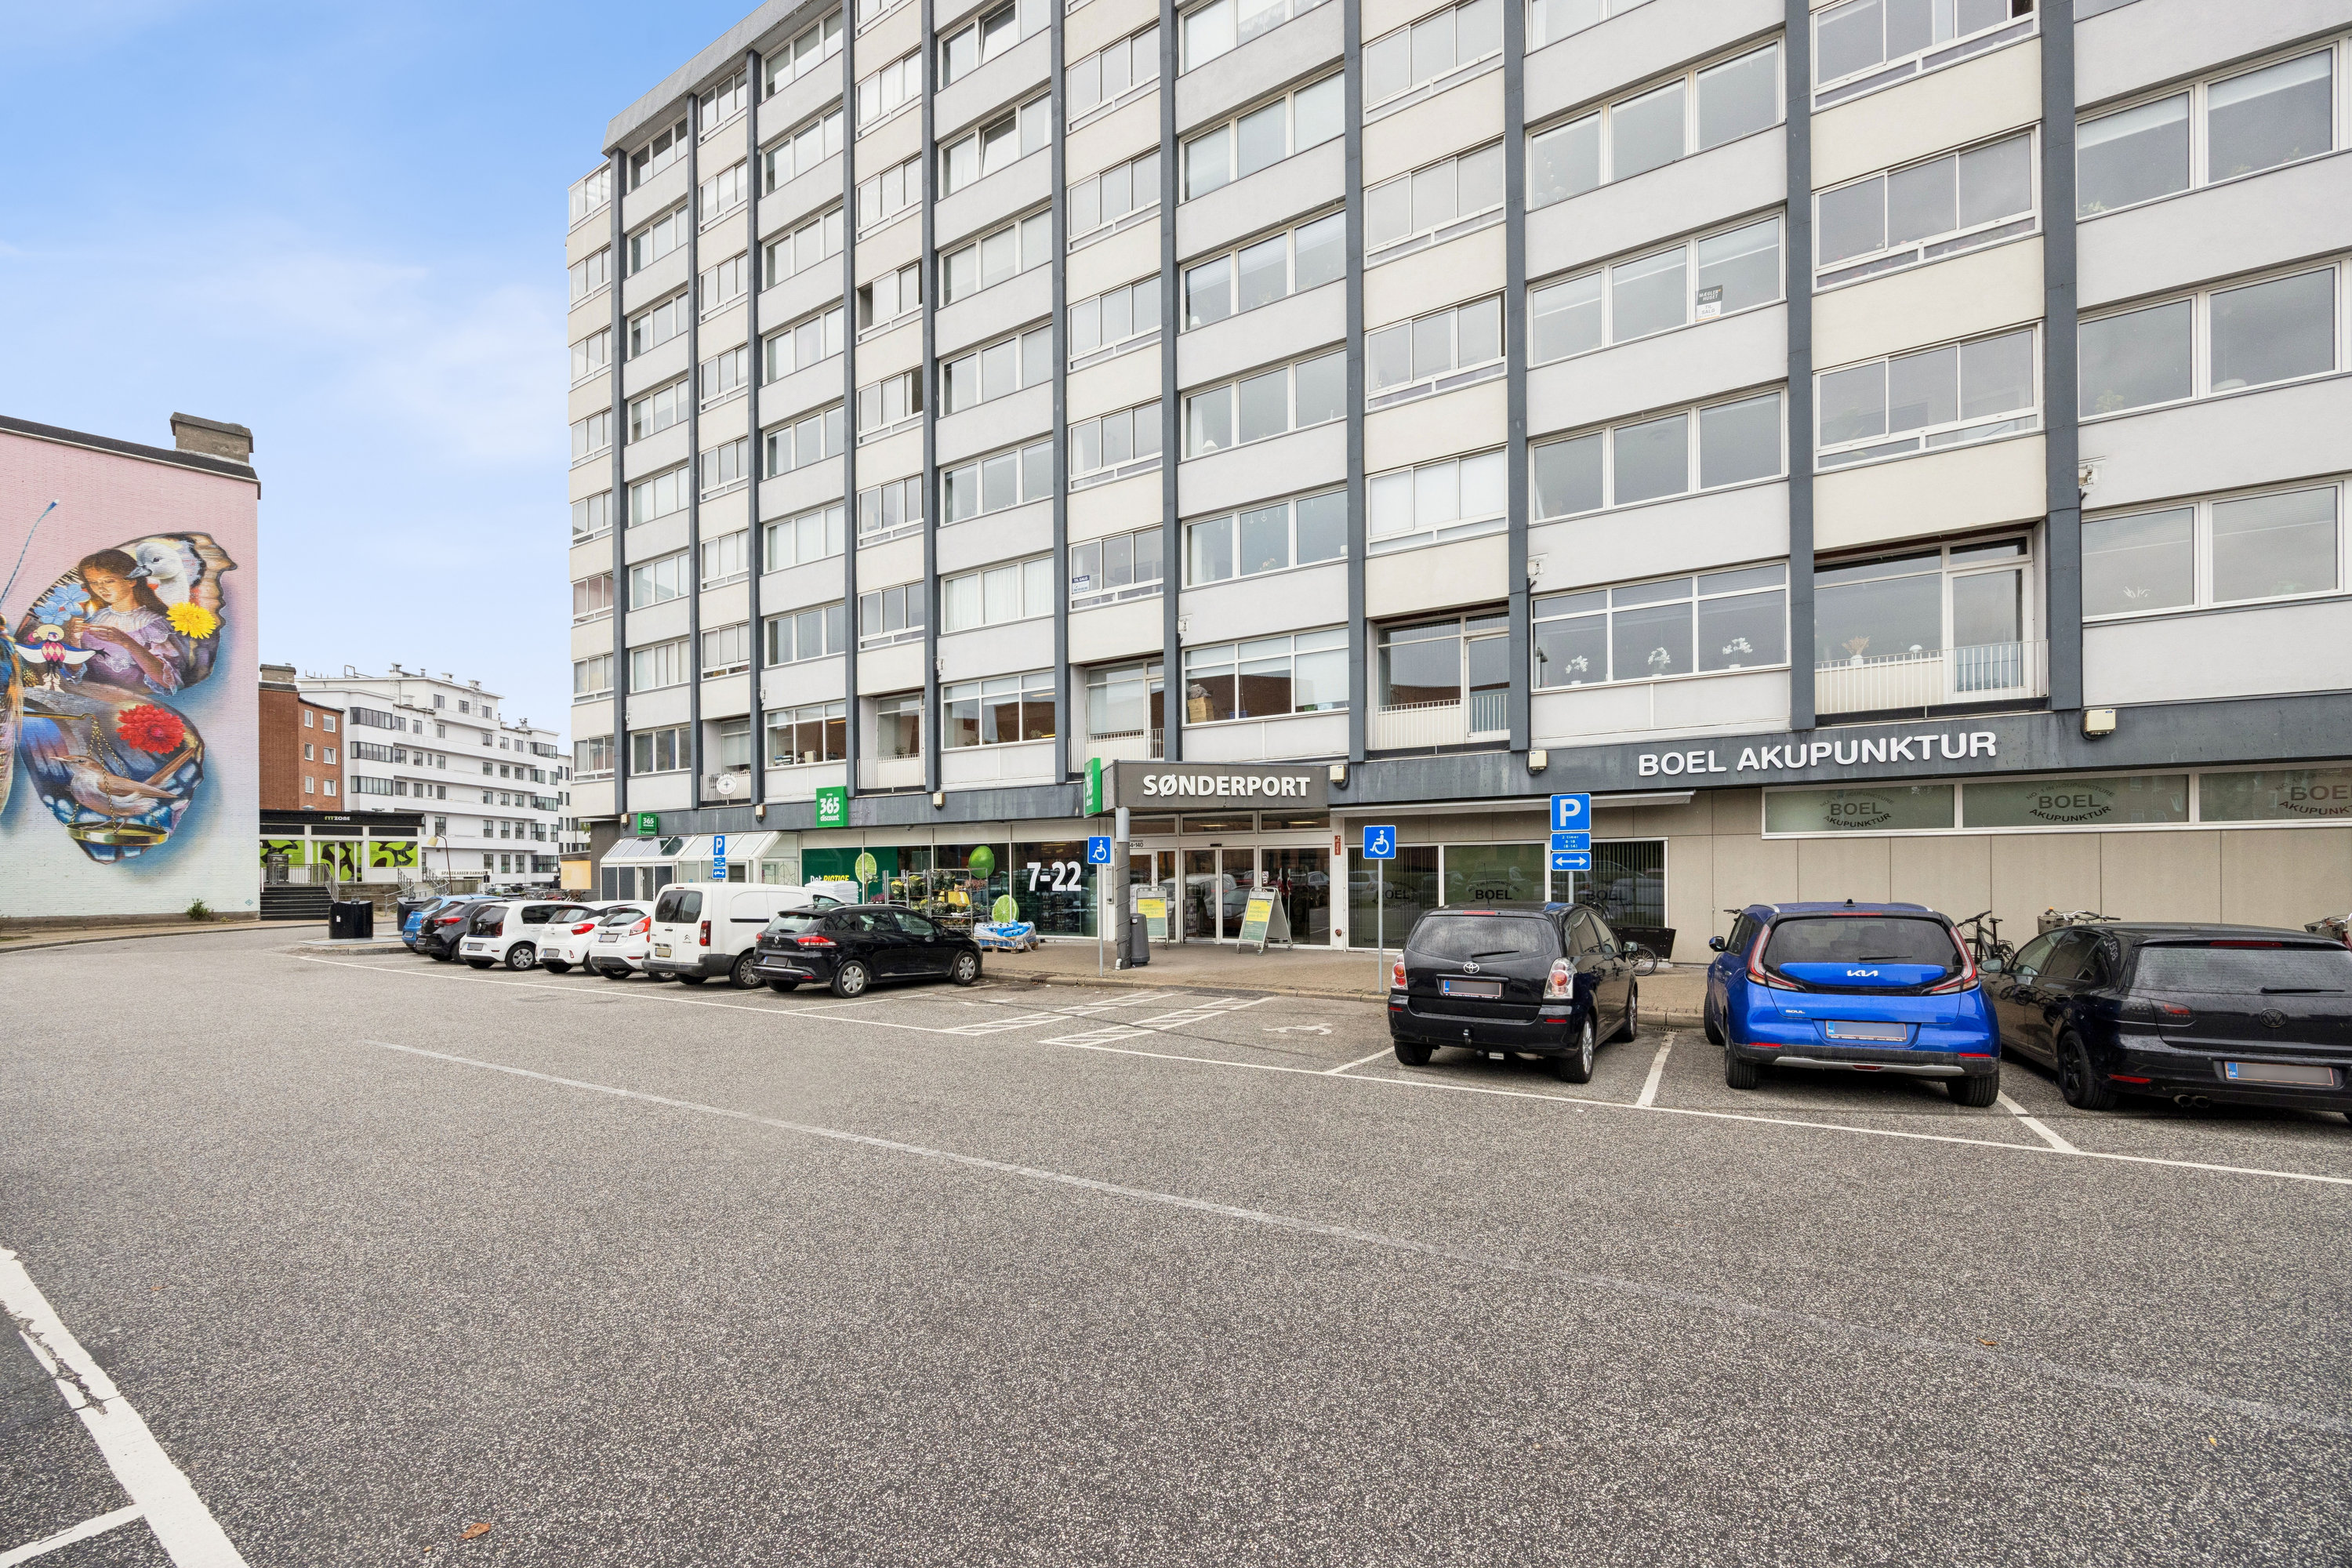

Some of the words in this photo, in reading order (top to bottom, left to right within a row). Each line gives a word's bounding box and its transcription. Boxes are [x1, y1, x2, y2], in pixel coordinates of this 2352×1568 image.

[1638, 750, 1727, 777] BOEL
[1736, 731, 1997, 771] AKUPUNKTUR
[1143, 773, 1311, 797] SØNDERPORT
[2291, 785, 2352, 800] BOE
[820, 797, 840, 815] 365
[1830, 801, 1883, 816] BOEL
[2038, 794, 2101, 809] BOEL
[1559, 798, 1581, 827] P
[1823, 813, 1892, 827] AKUPUNKTUR
[2029, 806, 2112, 822] AKUPUNKTUR
[716, 837, 723, 854] P
[1026, 861, 1082, 891] 7-22
[1377, 889, 1410, 900] OEL
[1475, 889, 1513, 900] BOEL
[1586, 889, 1628, 901] BOEL
